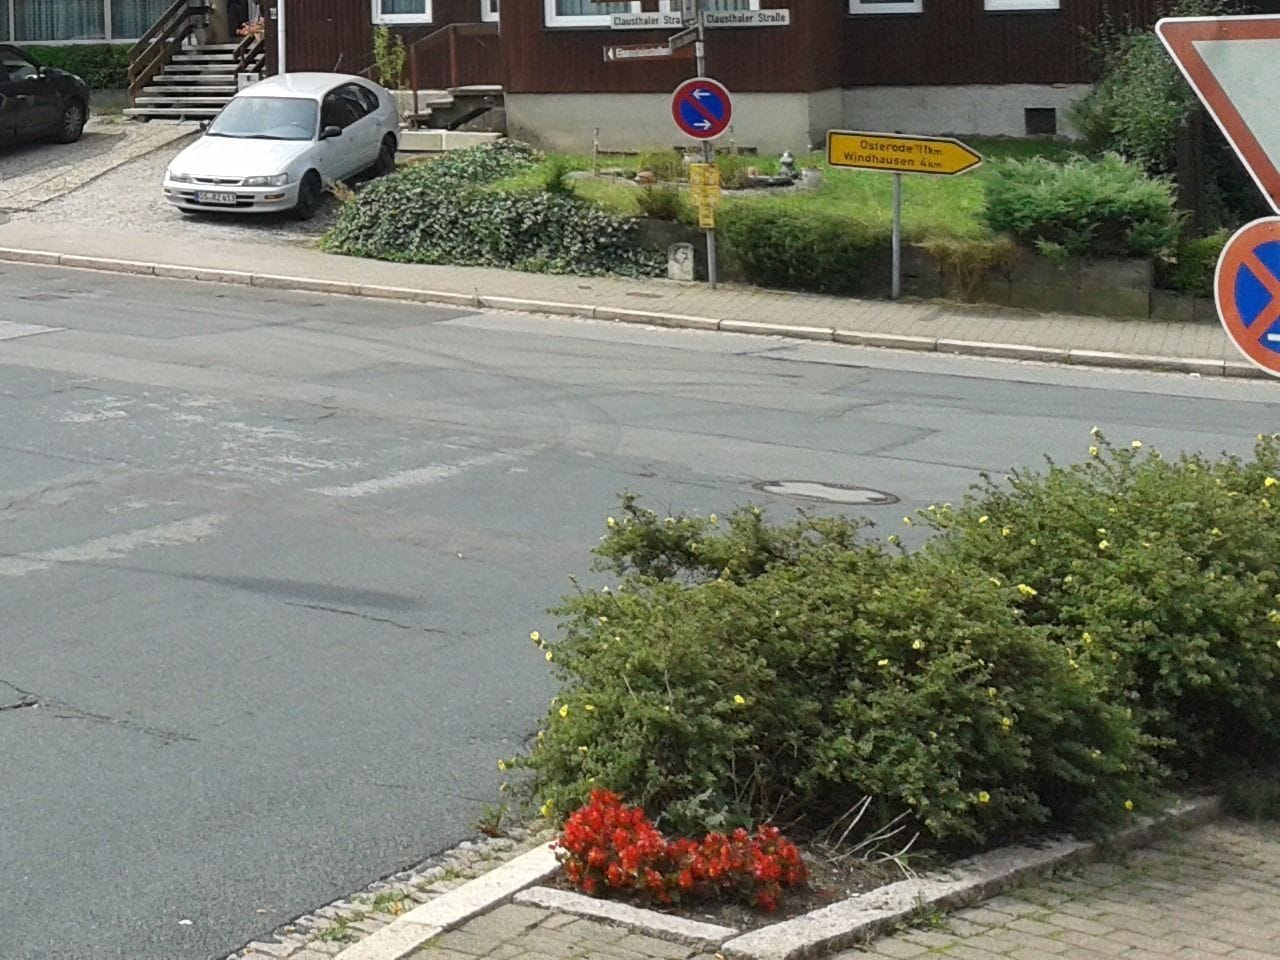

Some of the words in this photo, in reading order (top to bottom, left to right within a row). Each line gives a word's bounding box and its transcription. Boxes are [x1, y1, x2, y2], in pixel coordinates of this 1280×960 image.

[613, 15, 660, 26] Clausthaler
[663, 15, 680, 25] Stra
[706, 13, 754, 24] Clausthaler
[757, 12, 786, 23] Straße
[860, 139, 913, 154] Osterode
[843, 151, 915, 167] Windhausen
